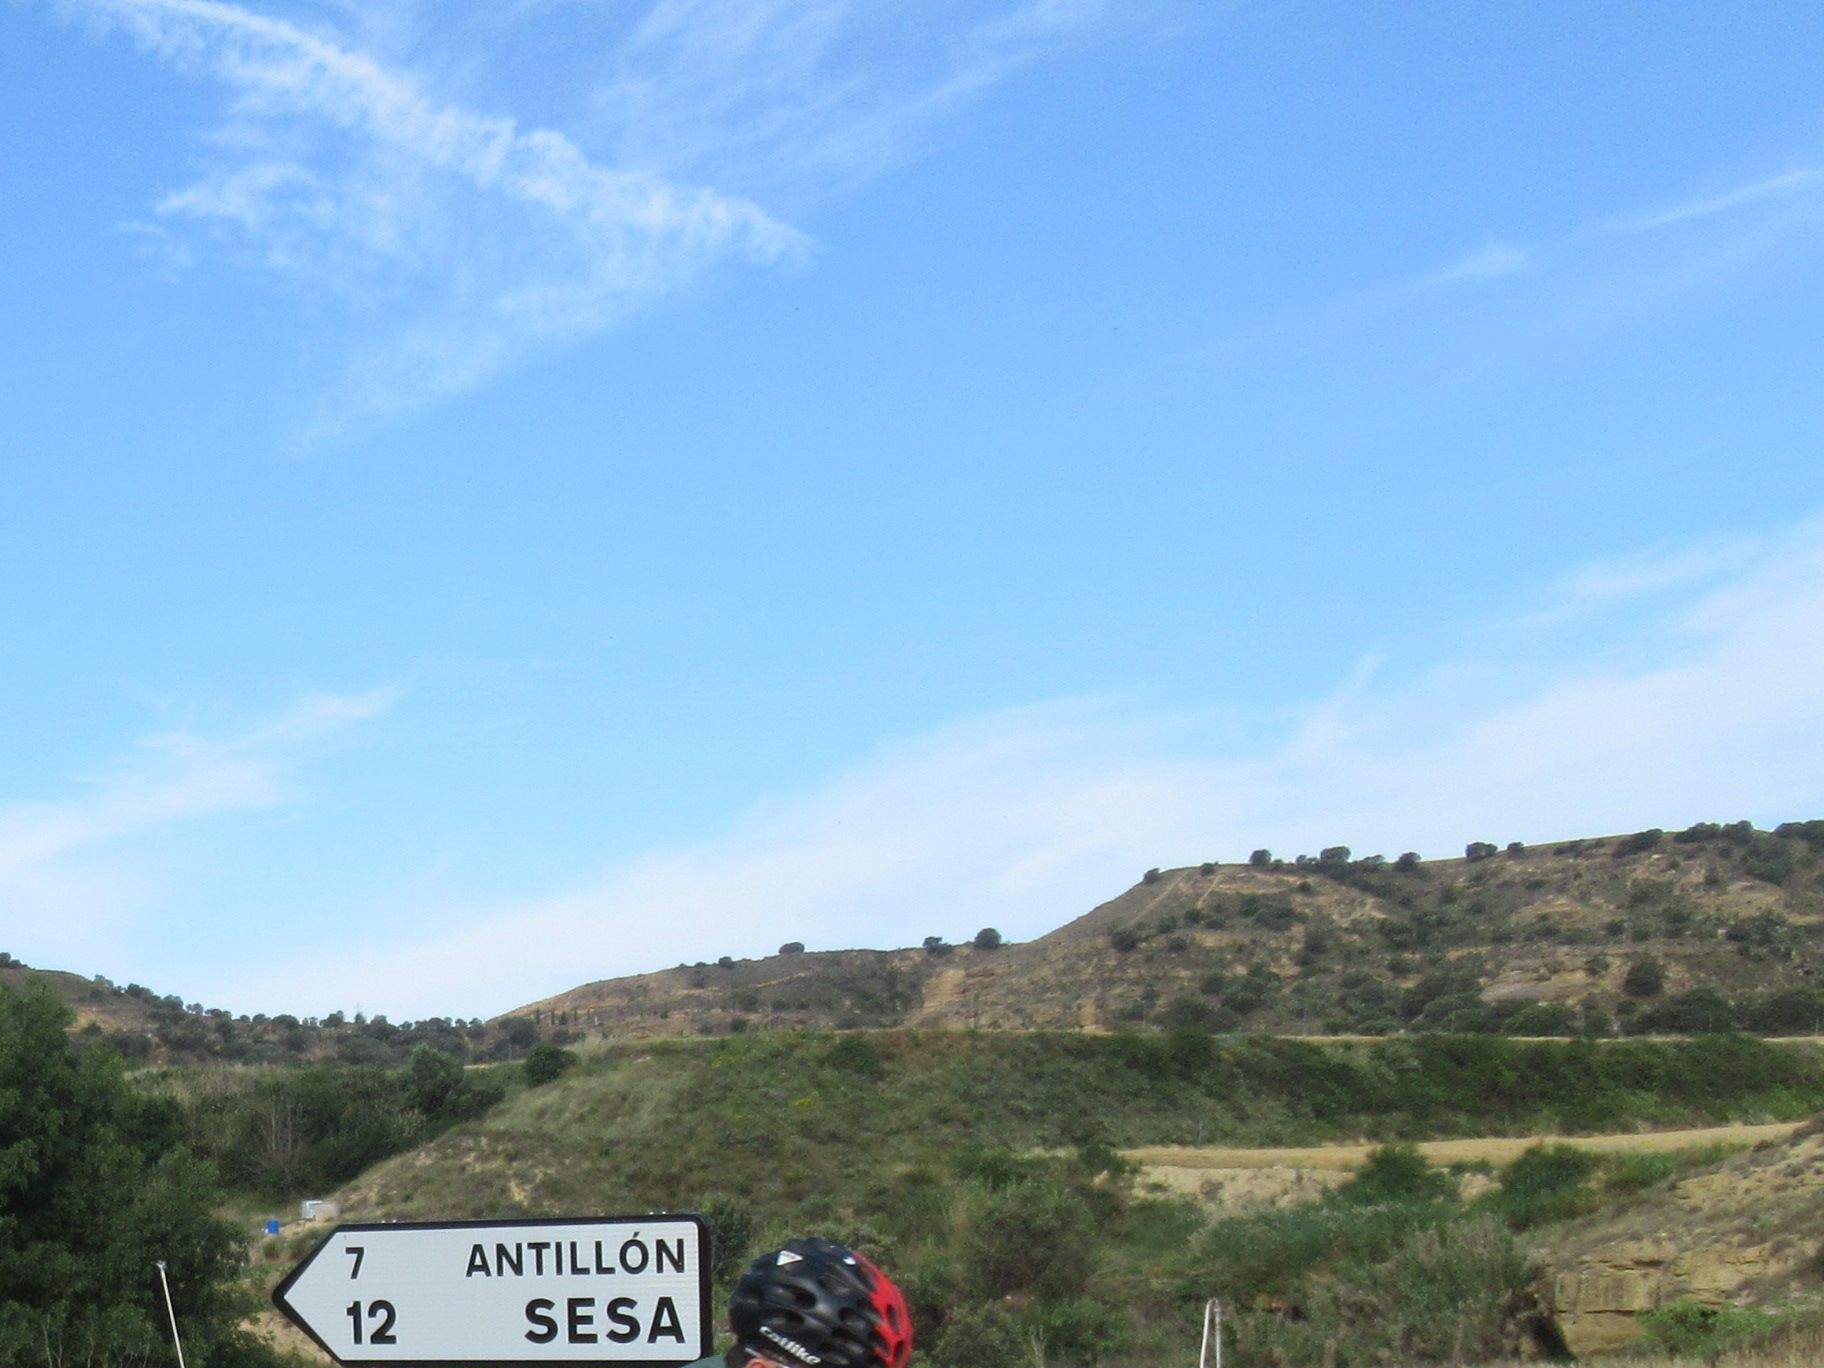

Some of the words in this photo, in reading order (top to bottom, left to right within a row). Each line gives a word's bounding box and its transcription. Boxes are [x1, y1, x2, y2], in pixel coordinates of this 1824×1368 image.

[345, 1246, 365, 1279] 7
[465, 1231, 685, 1278] ANTILLÓN
[346, 1299, 397, 1346] 12
[524, 1296, 686, 1345] SESA
